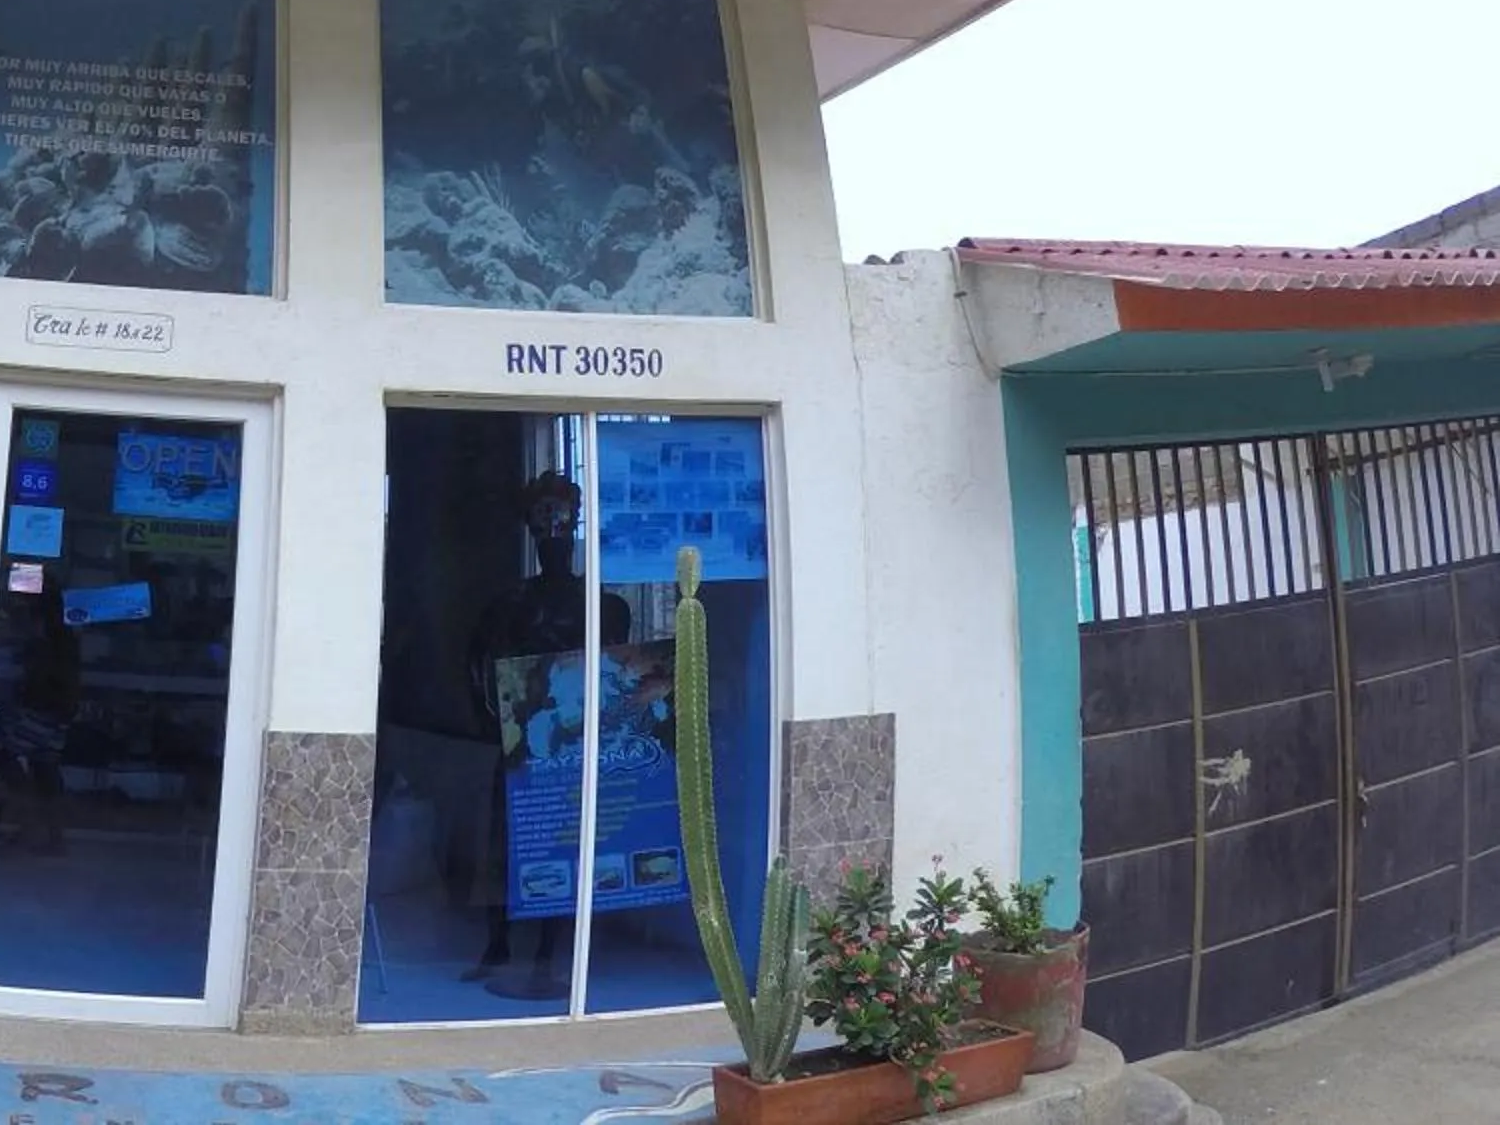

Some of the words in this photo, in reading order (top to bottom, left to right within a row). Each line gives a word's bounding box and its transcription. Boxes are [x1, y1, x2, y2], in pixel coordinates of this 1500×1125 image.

[25, 58, 62, 74] MUY
[66, 61, 130, 78] ARRIBA
[136, 67, 170, 82] QUE
[7, 75, 45, 90] MUY
[49, 79, 115, 95] RAPIDO
[119, 84, 154, 98] QUE
[157, 86, 211, 102] VAYAS
[214, 92, 228, 104] O
[10, 95, 49, 110] MUY
[52, 99, 95, 114] ALTO
[98, 102, 134, 117] QUE
[55, 116, 90, 133] VER
[94, 121, 115, 135] EL
[117, 122, 153, 136] 70%
[157, 125, 192, 140] DEL
[4, 133, 63, 150] TIENES
[67, 137, 106, 154] QUE
[95, 321, 108, 338] #
[506, 343, 567, 374] RNT
[574, 345, 663, 378] 30350
[120, 440, 238, 482] OPEN
